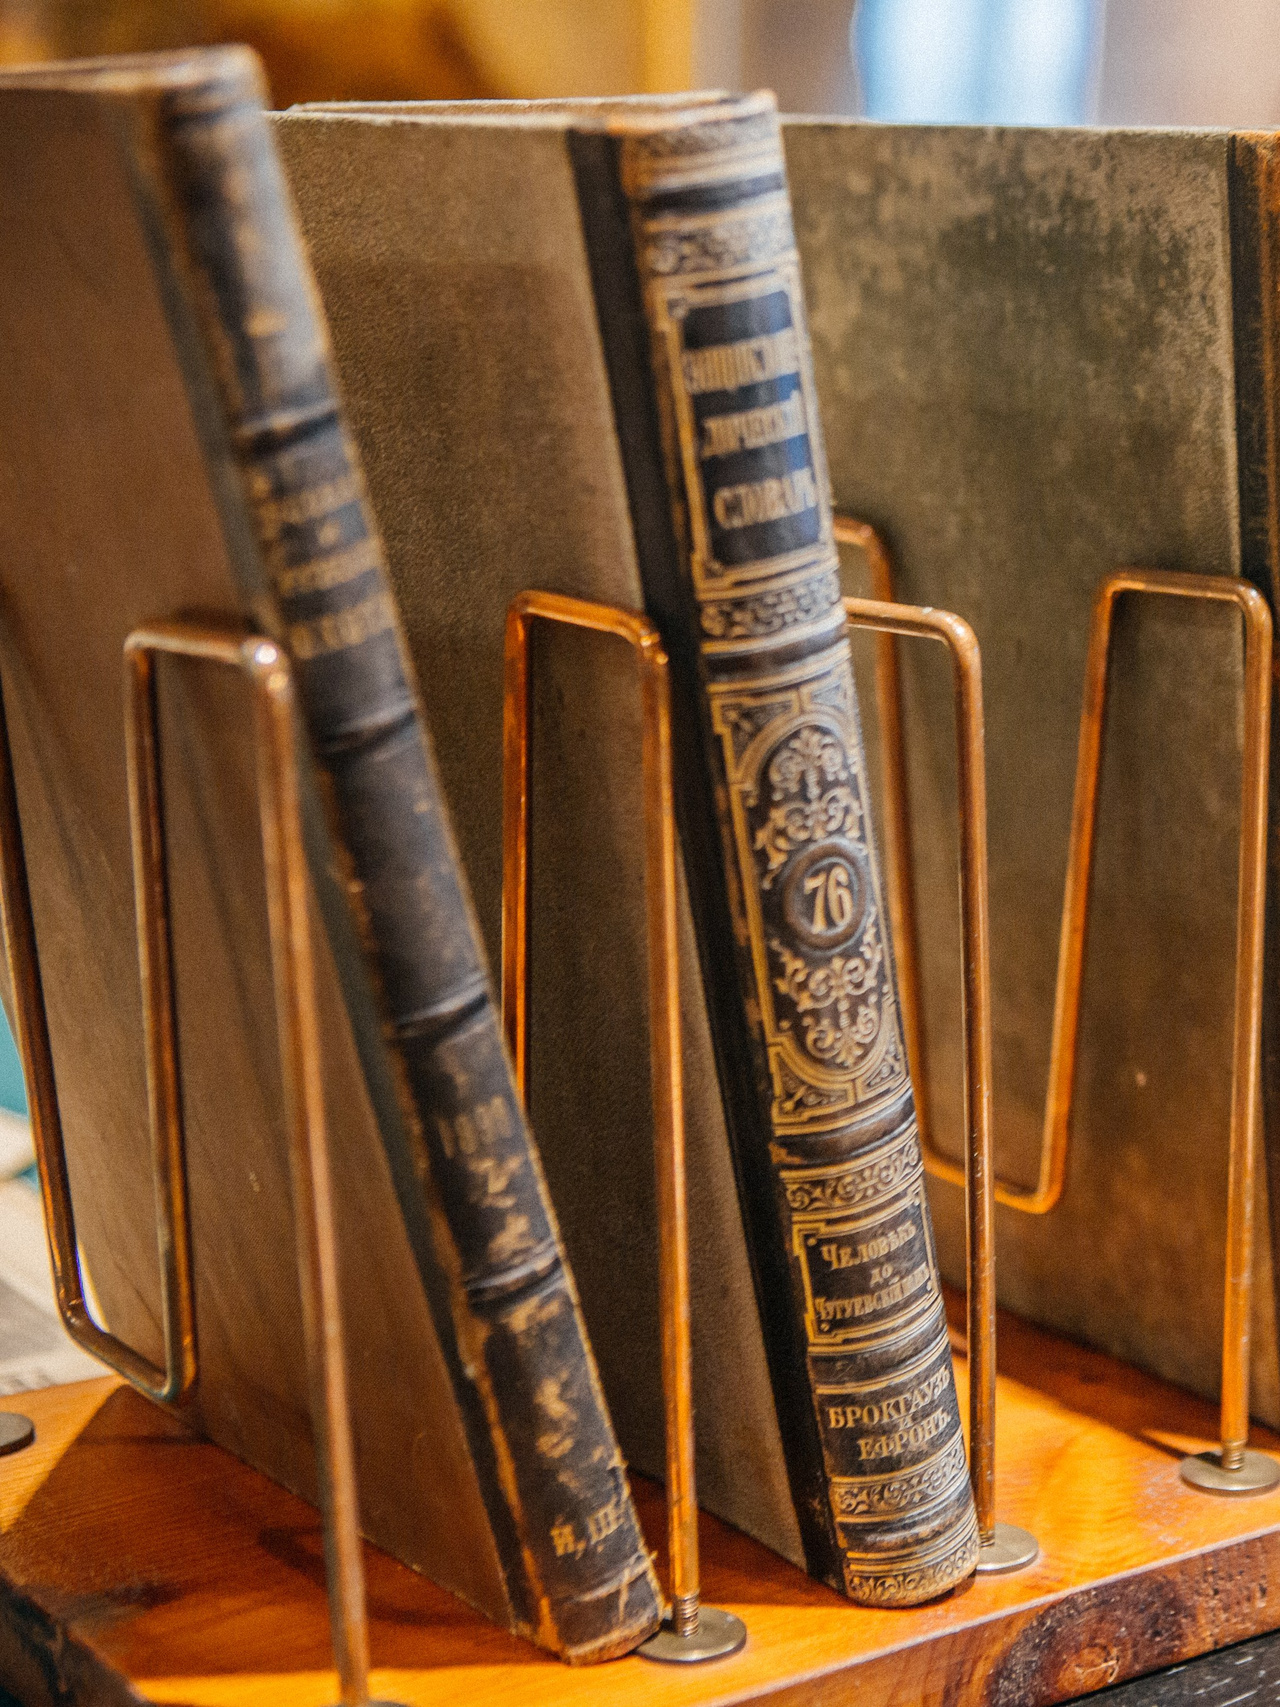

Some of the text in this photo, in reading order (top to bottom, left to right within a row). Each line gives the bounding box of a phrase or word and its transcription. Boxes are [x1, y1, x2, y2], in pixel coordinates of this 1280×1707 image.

[803, 865, 854, 934] 76
[826, 1364, 950, 1429] БРОКГАУЗЪ
[856, 1406, 951, 1461] ЕФРОНЪ
